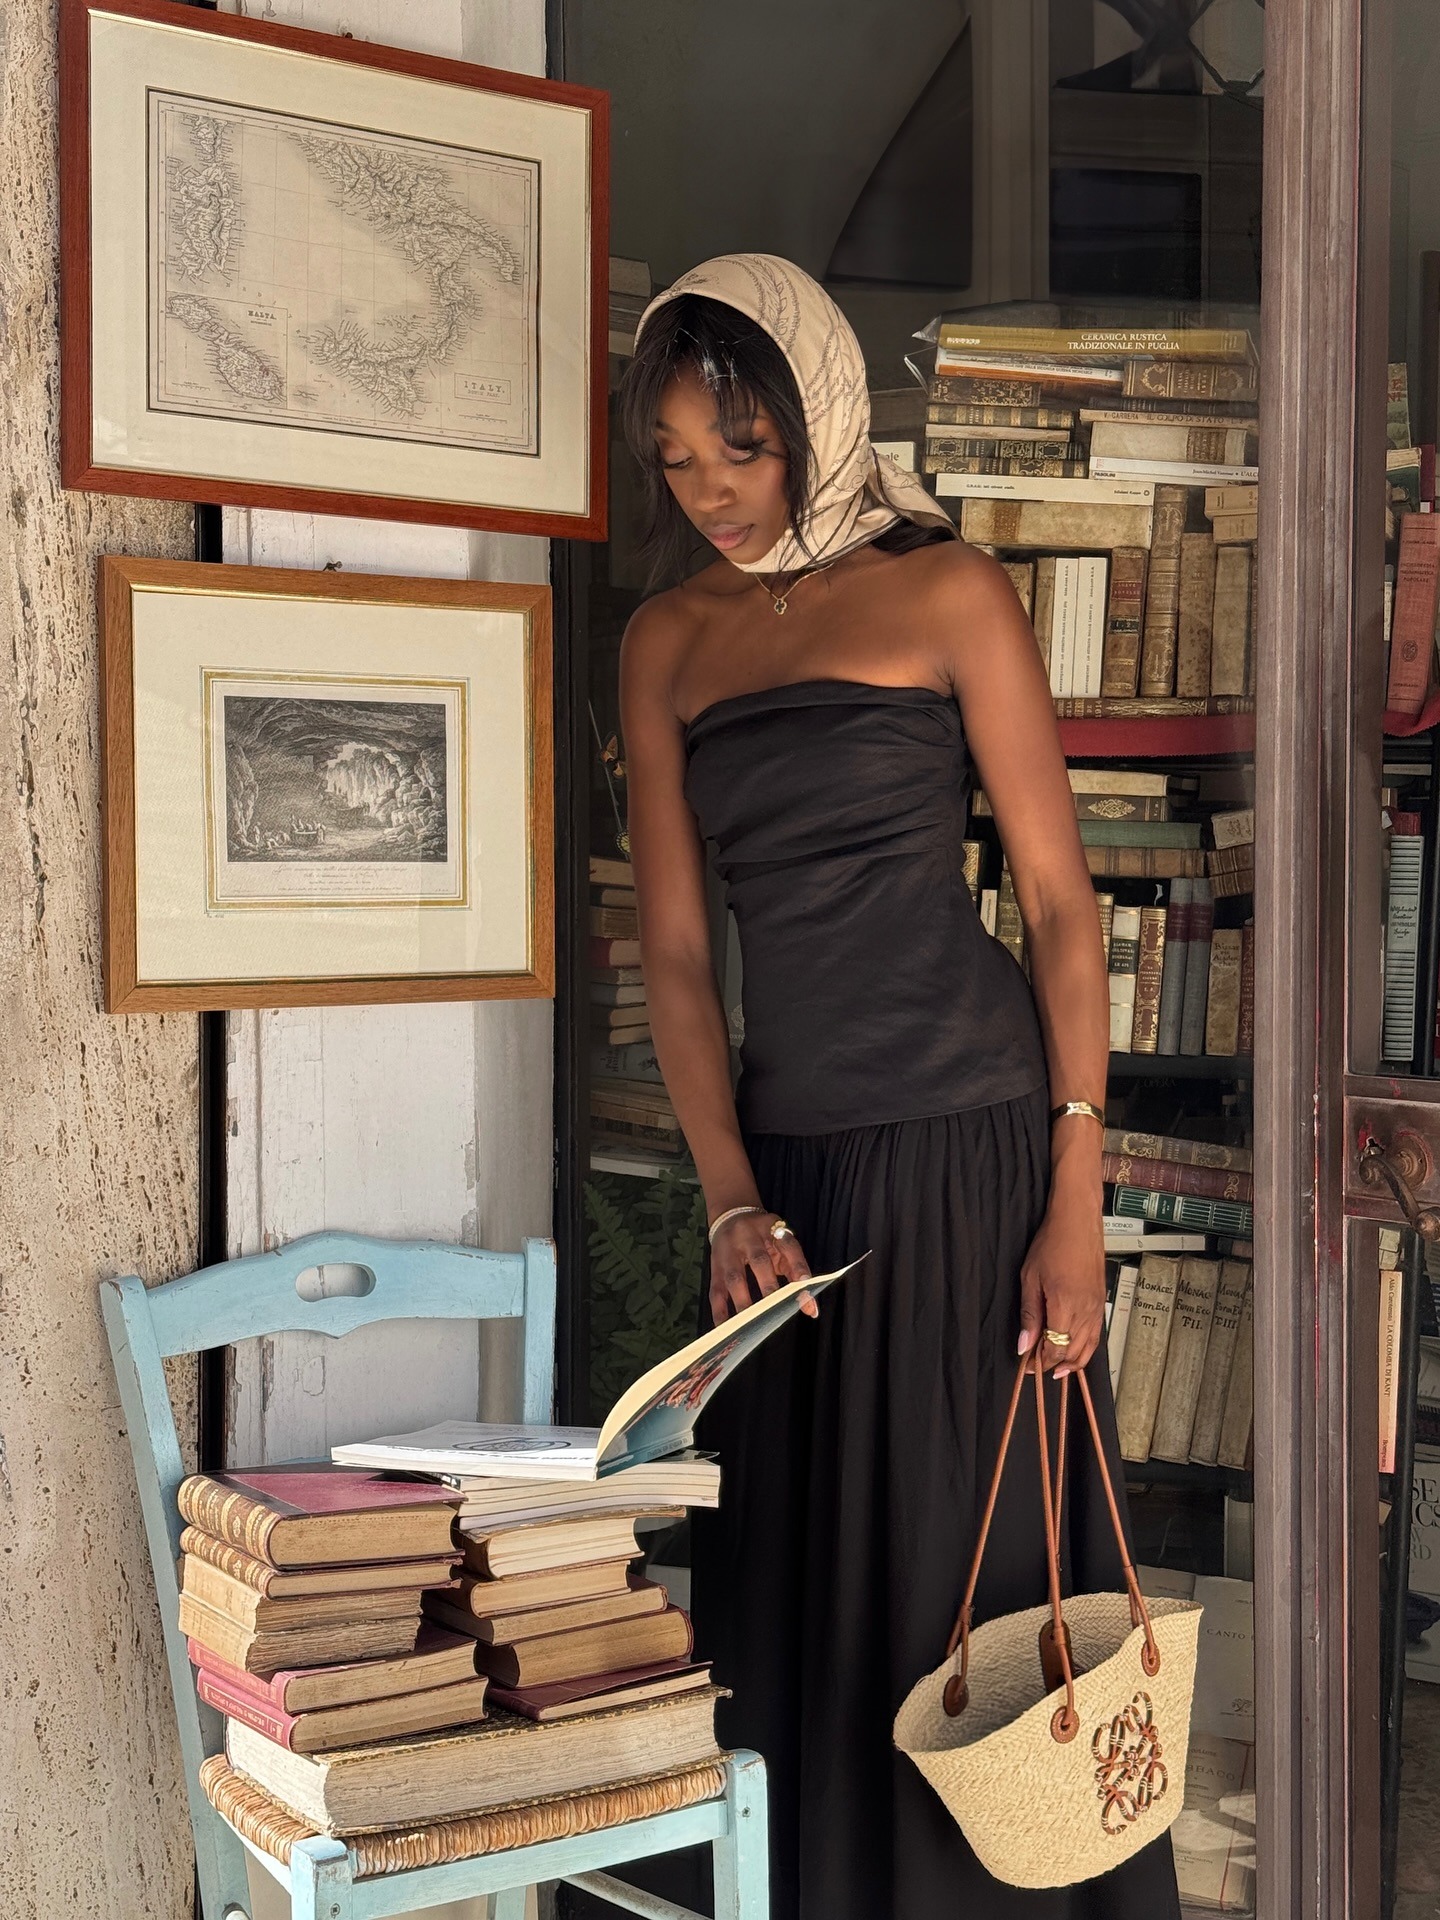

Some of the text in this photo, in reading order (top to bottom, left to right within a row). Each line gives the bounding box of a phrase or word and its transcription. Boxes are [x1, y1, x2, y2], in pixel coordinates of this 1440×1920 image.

[1081, 333, 1168, 342] CERAMICA RUSTICA
[1067, 341, 1180, 351] TRADIZIONALE IN PUGLIA
[464, 381, 505, 393] ITALY.
[1111, 412, 1139, 420] CARRERA
[1147, 413, 1154, 421] IL
[1156, 414, 1184, 422] COLPO
[1196, 416, 1225, 424] STATO
[1387, 1289, 1395, 1322] Carotenuto
[1387, 1324, 1394, 1332] LA
[1385, 1333, 1393, 1366] COLOMBA
[1385, 1367, 1392, 1376] DI
[1206, 1628, 1246, 1640] CANTO
[1186, 1764, 1235, 1782] BBACO
